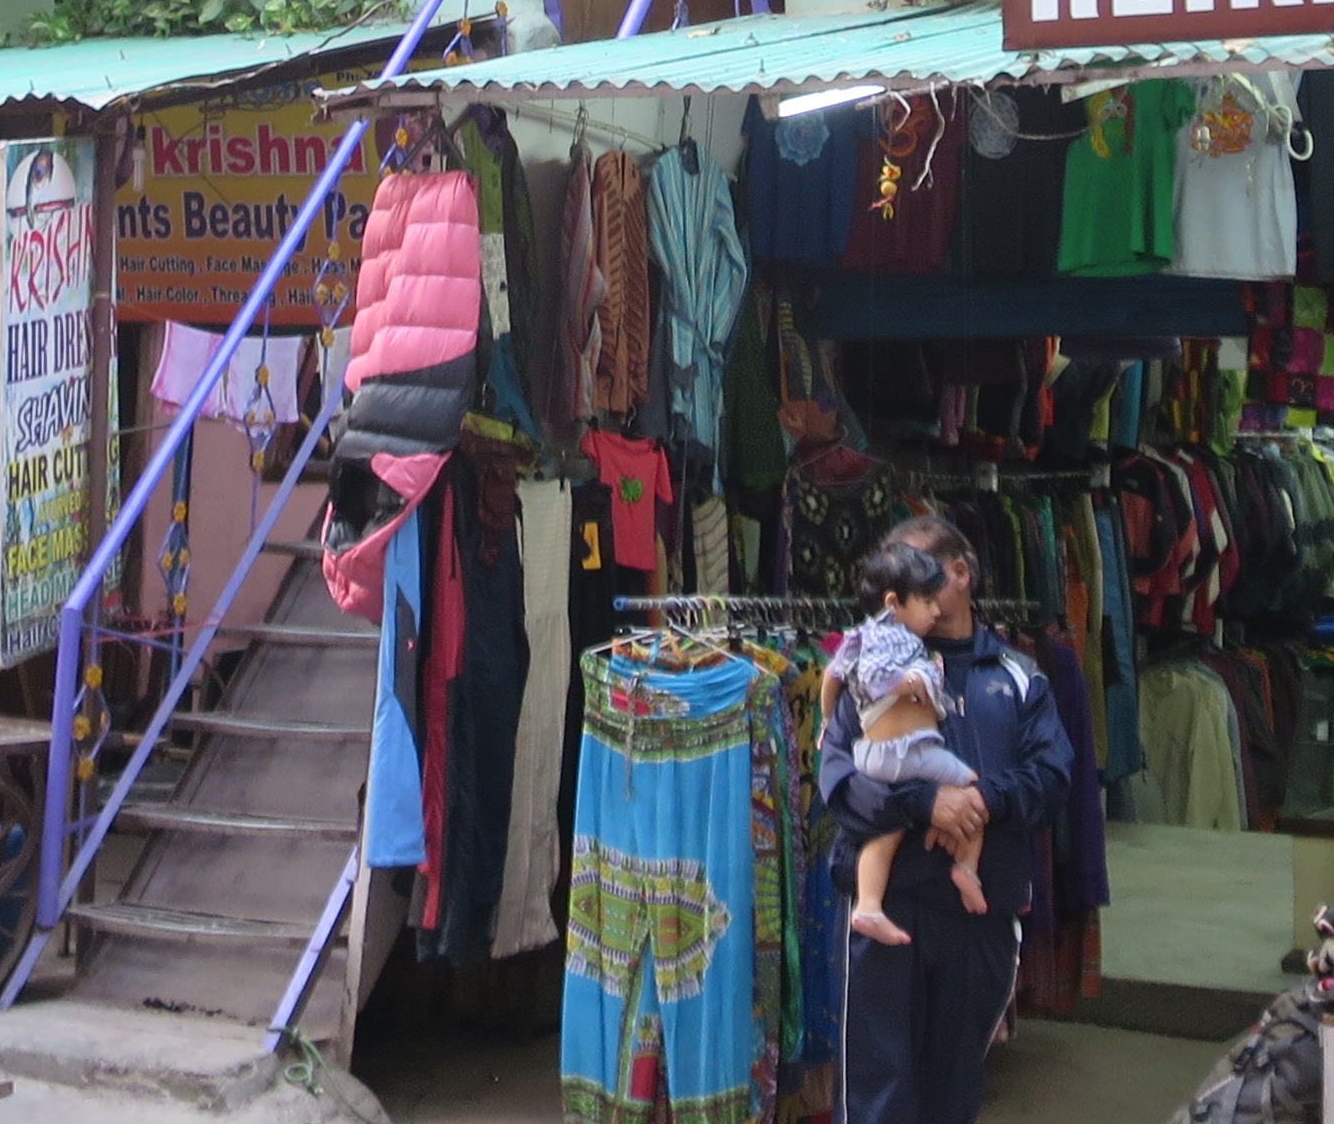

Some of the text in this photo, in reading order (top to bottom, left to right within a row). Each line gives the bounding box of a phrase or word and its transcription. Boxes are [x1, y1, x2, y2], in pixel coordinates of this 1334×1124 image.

[150, 123, 367, 176] krishna
[117, 193, 172, 240] nts
[9, 203, 95, 316] KRISHN
[120, 256, 147, 273] Hair
[149, 256, 196, 275] Cutting
[206, 257, 238, 273] Face
[241, 258, 299, 276] Masge
[137, 286, 170, 303] Hair
[171, 286, 200, 303] Color
[7, 318, 49, 384] HAIR
[16, 375, 94, 453] SHAVIN
[7, 455, 49, 503] HAIR
[7, 534, 48, 577] FACE
[7, 582, 52, 624] HEAD
